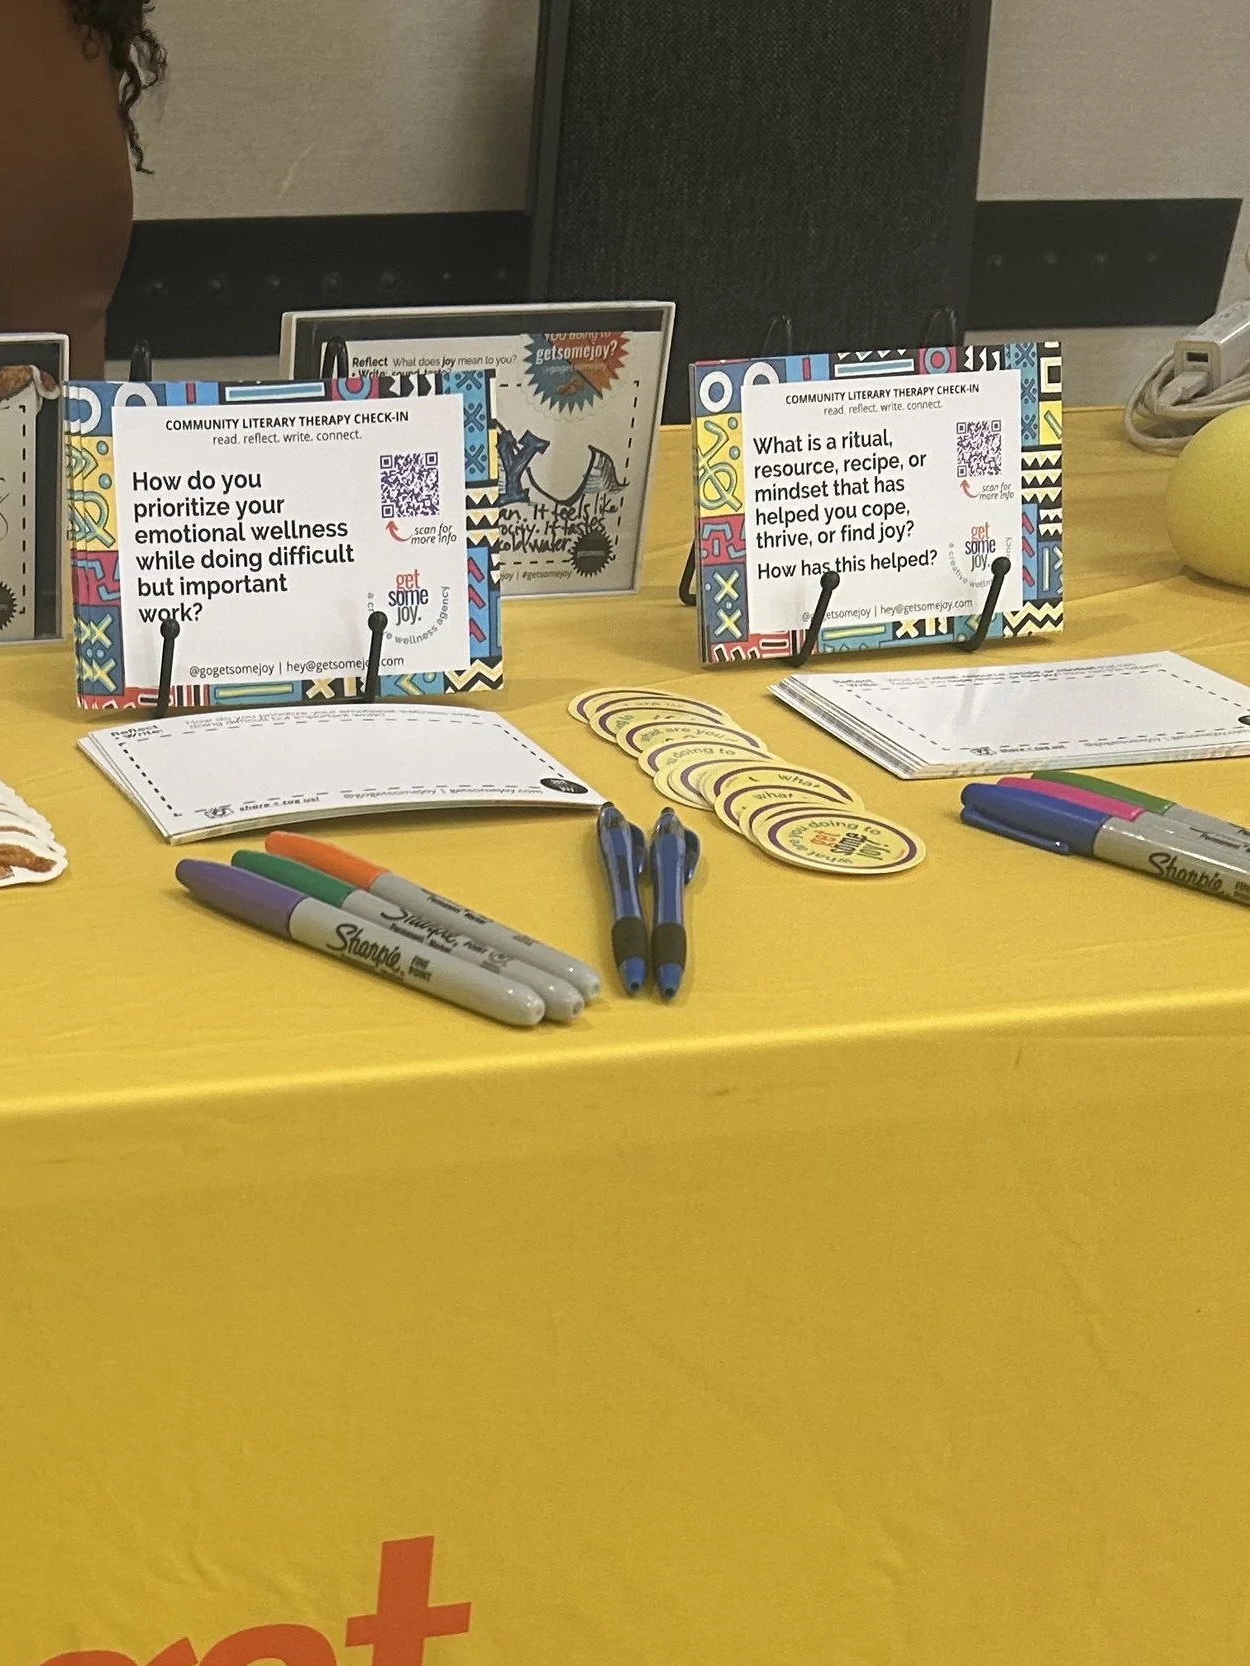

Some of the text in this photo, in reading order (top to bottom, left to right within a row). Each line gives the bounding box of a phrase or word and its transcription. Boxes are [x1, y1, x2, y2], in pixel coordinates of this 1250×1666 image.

[352, 354, 517, 368] Reflect What does joy mean to you?
[536, 340, 618, 364] getsomejoy?
[786, 384, 980, 404] COMMUNITY LITERARY THERAPY CHECK-IN
[849, 404, 878, 414] reflect.
[880, 402, 905, 412] write.
[907, 400, 943, 410] connect.
[166, 411, 409, 432] COMMUNITY LITERARY THERAPY CHECK-IN
[213, 430, 362, 445] read. reflect. write. connect.
[753, 428, 893, 454] What is a ritual,
[754, 453, 927, 478] resource, recipe, or
[132, 470, 262, 495] How do you
[755, 476, 905, 502] mindset that has
[134, 497, 285, 523] prioritize your
[551, 494, 590, 522] feels
[756, 501, 910, 528] helped you cope,
[135, 520, 349, 544] emotional wellness
[411, 533, 457, 545] more info
[414, 523, 453, 537] scan for
[756, 520, 915, 549] thrive, or find joy?
[971, 522, 990, 542] get
[135, 543, 355, 572] while doing difficult
[965, 539, 996, 555] some
[758, 549, 937, 579] How has this helped?
[970, 554, 990, 572] joy.
[138, 574, 288, 600] but important
[396, 569, 420, 594] get
[388, 588, 429, 606] some
[880, 599, 973, 616] hey@getsomejoy.com
[138, 602, 203, 623] work?
[396, 605, 422, 626] joy.
[189, 662, 274, 679] @gogetsomejoy
[808, 820, 859, 830] doing
[864, 826, 881, 835] to
[830, 832, 868, 855] some
